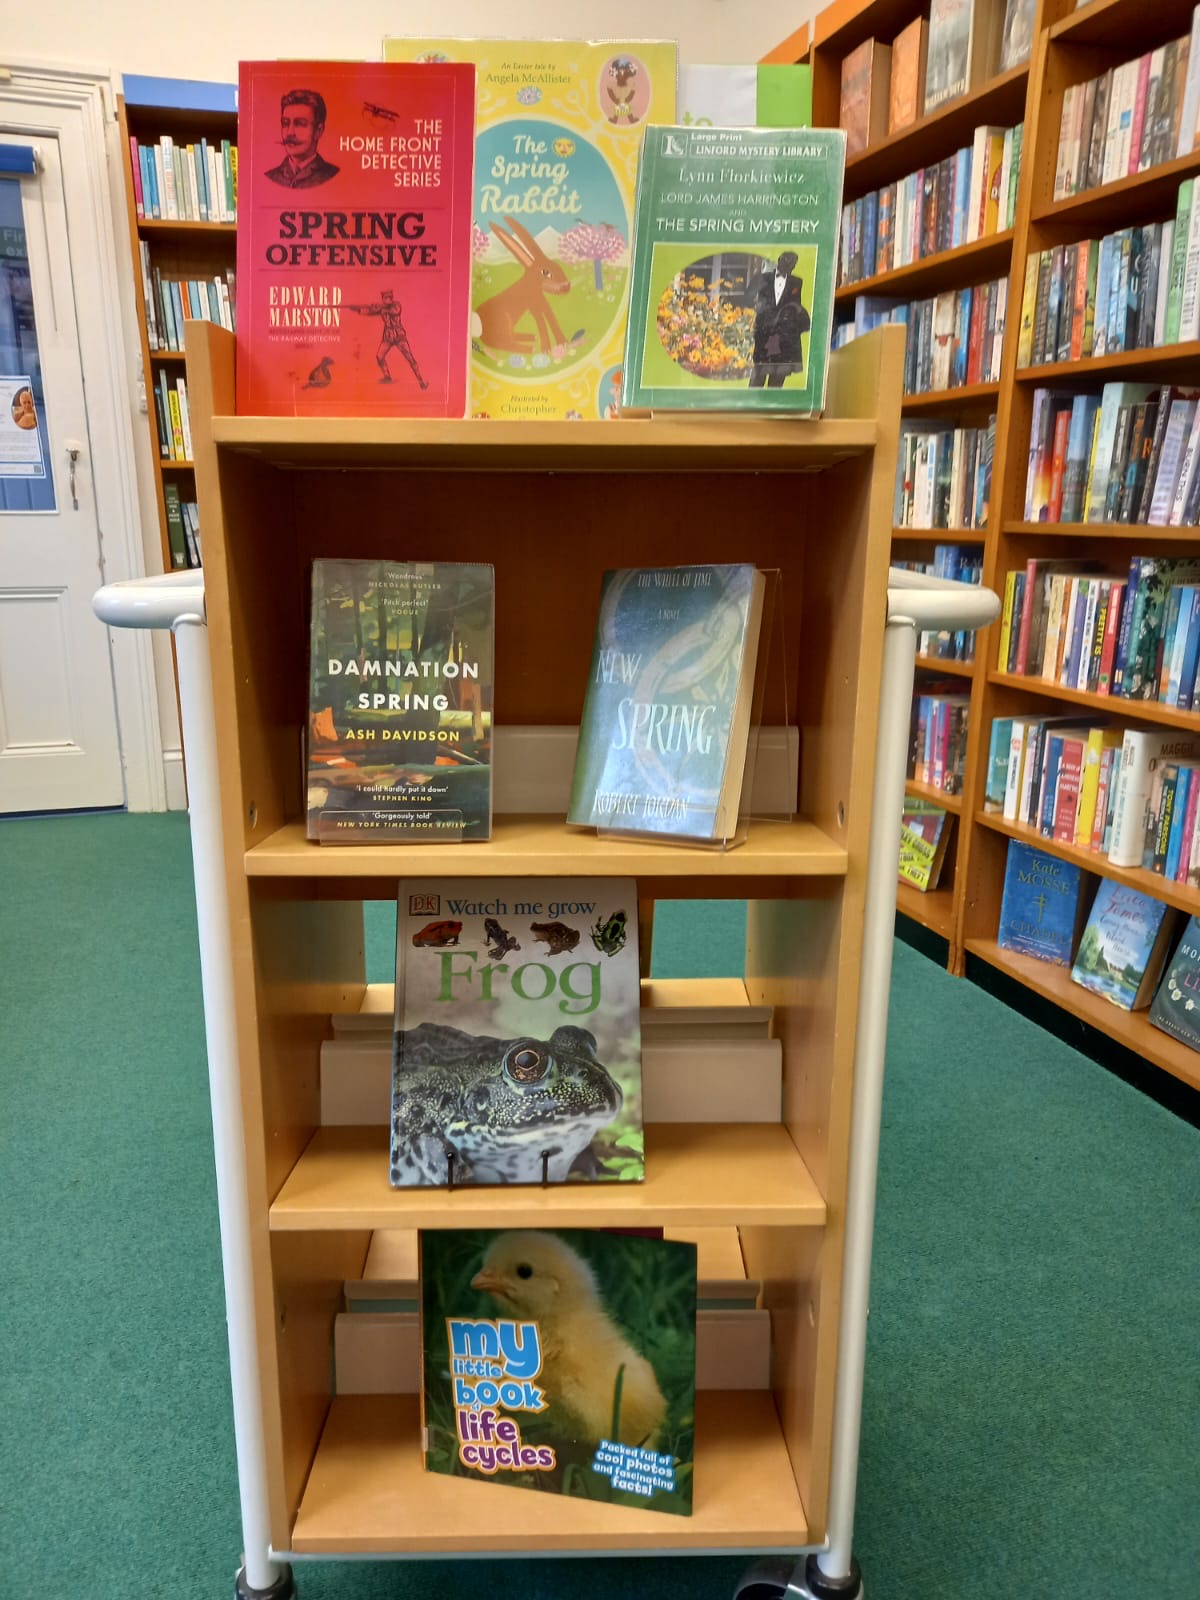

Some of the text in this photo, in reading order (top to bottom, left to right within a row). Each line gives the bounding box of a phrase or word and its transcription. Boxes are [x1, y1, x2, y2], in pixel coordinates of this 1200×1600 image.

[486, 73, 571, 85] Angela McAllister
[414, 119, 442, 134] THE
[340, 136, 441, 152] HOME FRONT
[513, 135, 547, 155] The
[691, 132, 742, 142] Large Print
[696, 145, 822, 157] LINFORD MYSTERY LIBRARY
[361, 154, 441, 170] DETECTIVE
[491, 155, 569, 184] Spring
[394, 172, 441, 187] SERIES
[679, 168, 714, 186] Lynn
[480, 185, 582, 214] Rabbit
[661, 192, 818, 206] LORD JAMES HARRINGTON
[279, 212, 426, 240] SPRING
[656, 218, 819, 233] THE SPRING MYSTERY
[266, 244, 437, 267] OFFENSIVE
[269, 286, 342, 305] EDWARD
[269, 307, 341, 327] MARSTON
[328, 659, 479, 679] DAMNATION
[595, 648, 642, 684] NEW
[358, 693, 449, 711] SPRING
[346, 729, 460, 742] ASH DAVIDSON
[611, 697, 716, 756] SPRING
[363, 785, 382, 793] could
[384, 785, 406, 794] hardly
[408, 786, 420, 794] put
[592, 789, 690, 819] ROBERT JORDAN
[1160, 814, 1171, 855] PARSONS
[1032, 860, 1059, 876] Kate
[1018, 870, 1071, 895] MOSSE
[414, 896, 597, 919] DK Watch me grow
[433, 951, 602, 1015] Frog
[1184, 972, 1200, 992] LI
[450, 1320, 541, 1379] my
[453, 1359, 503, 1377] little
[455, 1379, 544, 1410] book
[459, 1410, 517, 1441] life
[462, 1442, 553, 1469] cycles
[601, 1440, 671, 1465] Packed full of
[595, 1451, 673, 1478] cool photos
[593, 1463, 674, 1491] and fascinating
[612, 1475, 653, 1496] facts!
